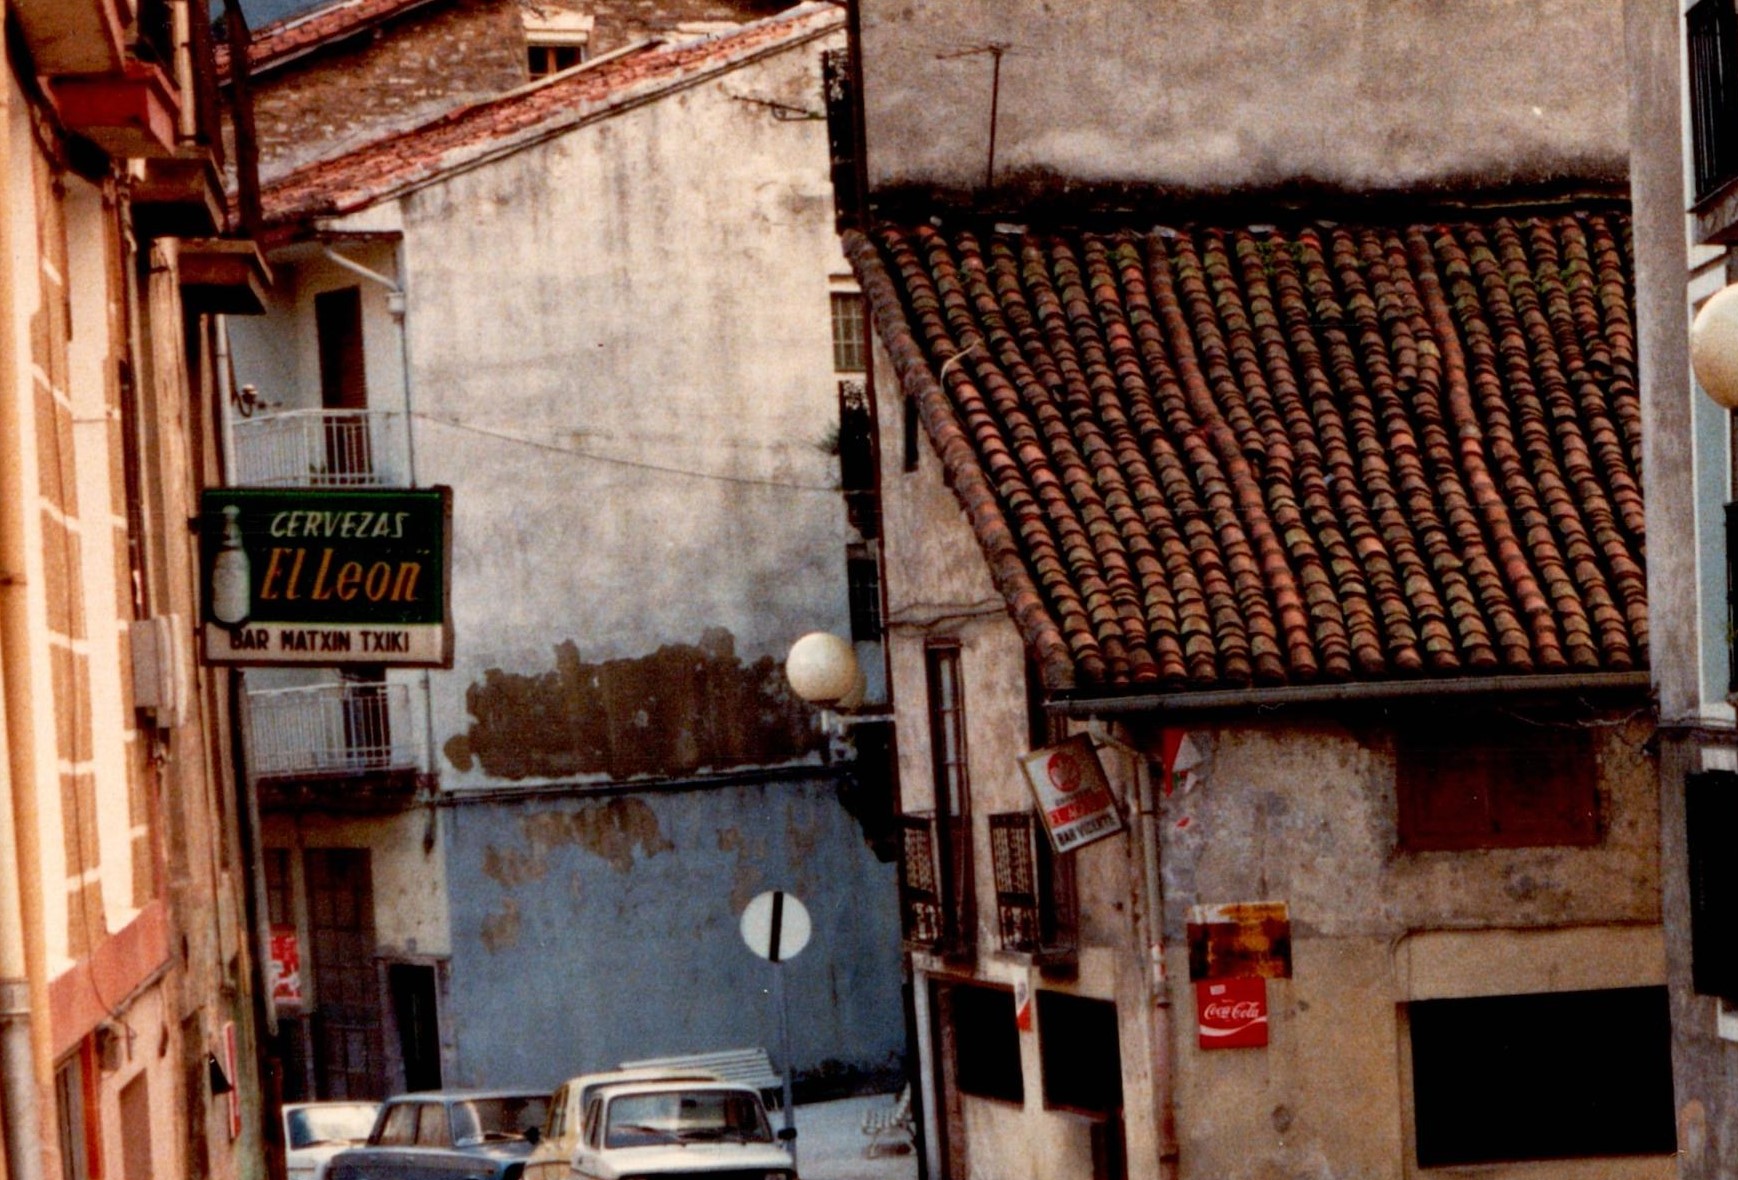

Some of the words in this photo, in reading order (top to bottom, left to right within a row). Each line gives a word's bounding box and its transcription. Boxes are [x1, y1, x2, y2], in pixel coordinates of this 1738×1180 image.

[270, 511, 410, 538] CERVEZAS
[230, 629, 270, 650] BAR
[281, 629, 351, 651] MATXIN
[360, 630, 410, 653] TXIKI
